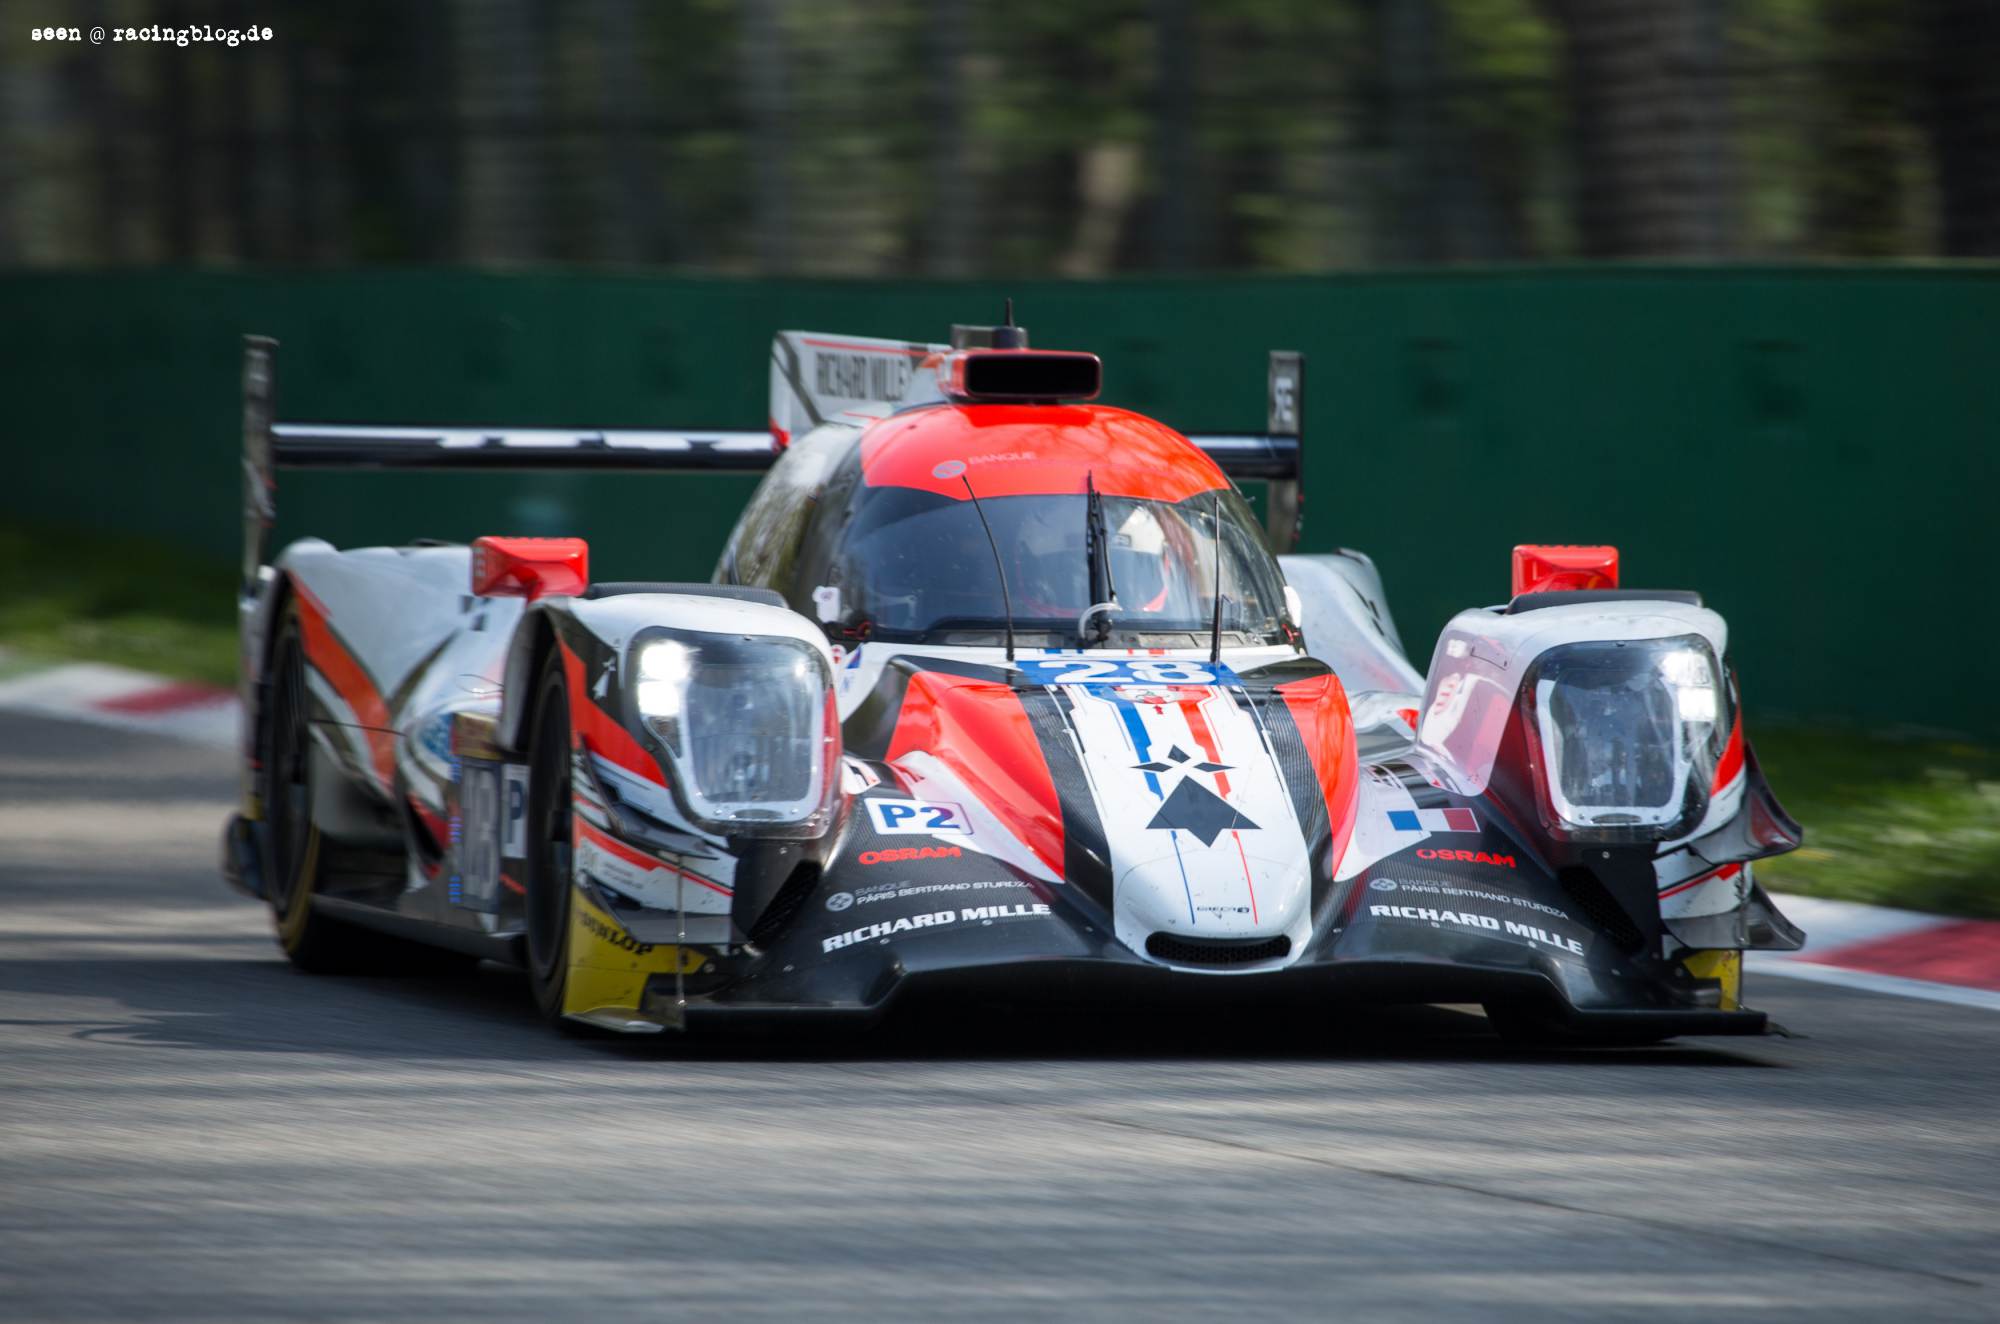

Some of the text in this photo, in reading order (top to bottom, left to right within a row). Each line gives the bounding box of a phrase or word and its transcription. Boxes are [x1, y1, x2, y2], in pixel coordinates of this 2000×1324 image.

[816, 352, 867, 399] RICHARD
[967, 450, 1037, 465] BANQUE
[1038, 660, 1217, 684] 28
[878, 803, 961, 829] P2
[858, 846, 962, 865] OSRAM
[1416, 849, 1516, 869] OSRAM
[898, 882, 971, 897] BERTRAND
[1442, 887, 1511, 904] BERTRAND
[1512, 897, 1570, 921] STURDZA
[580, 911, 654, 956] DUNLOP
[822, 902, 1053, 954] RICHARD MILLE
[1369, 904, 1585, 957] RICHARD MILLE
